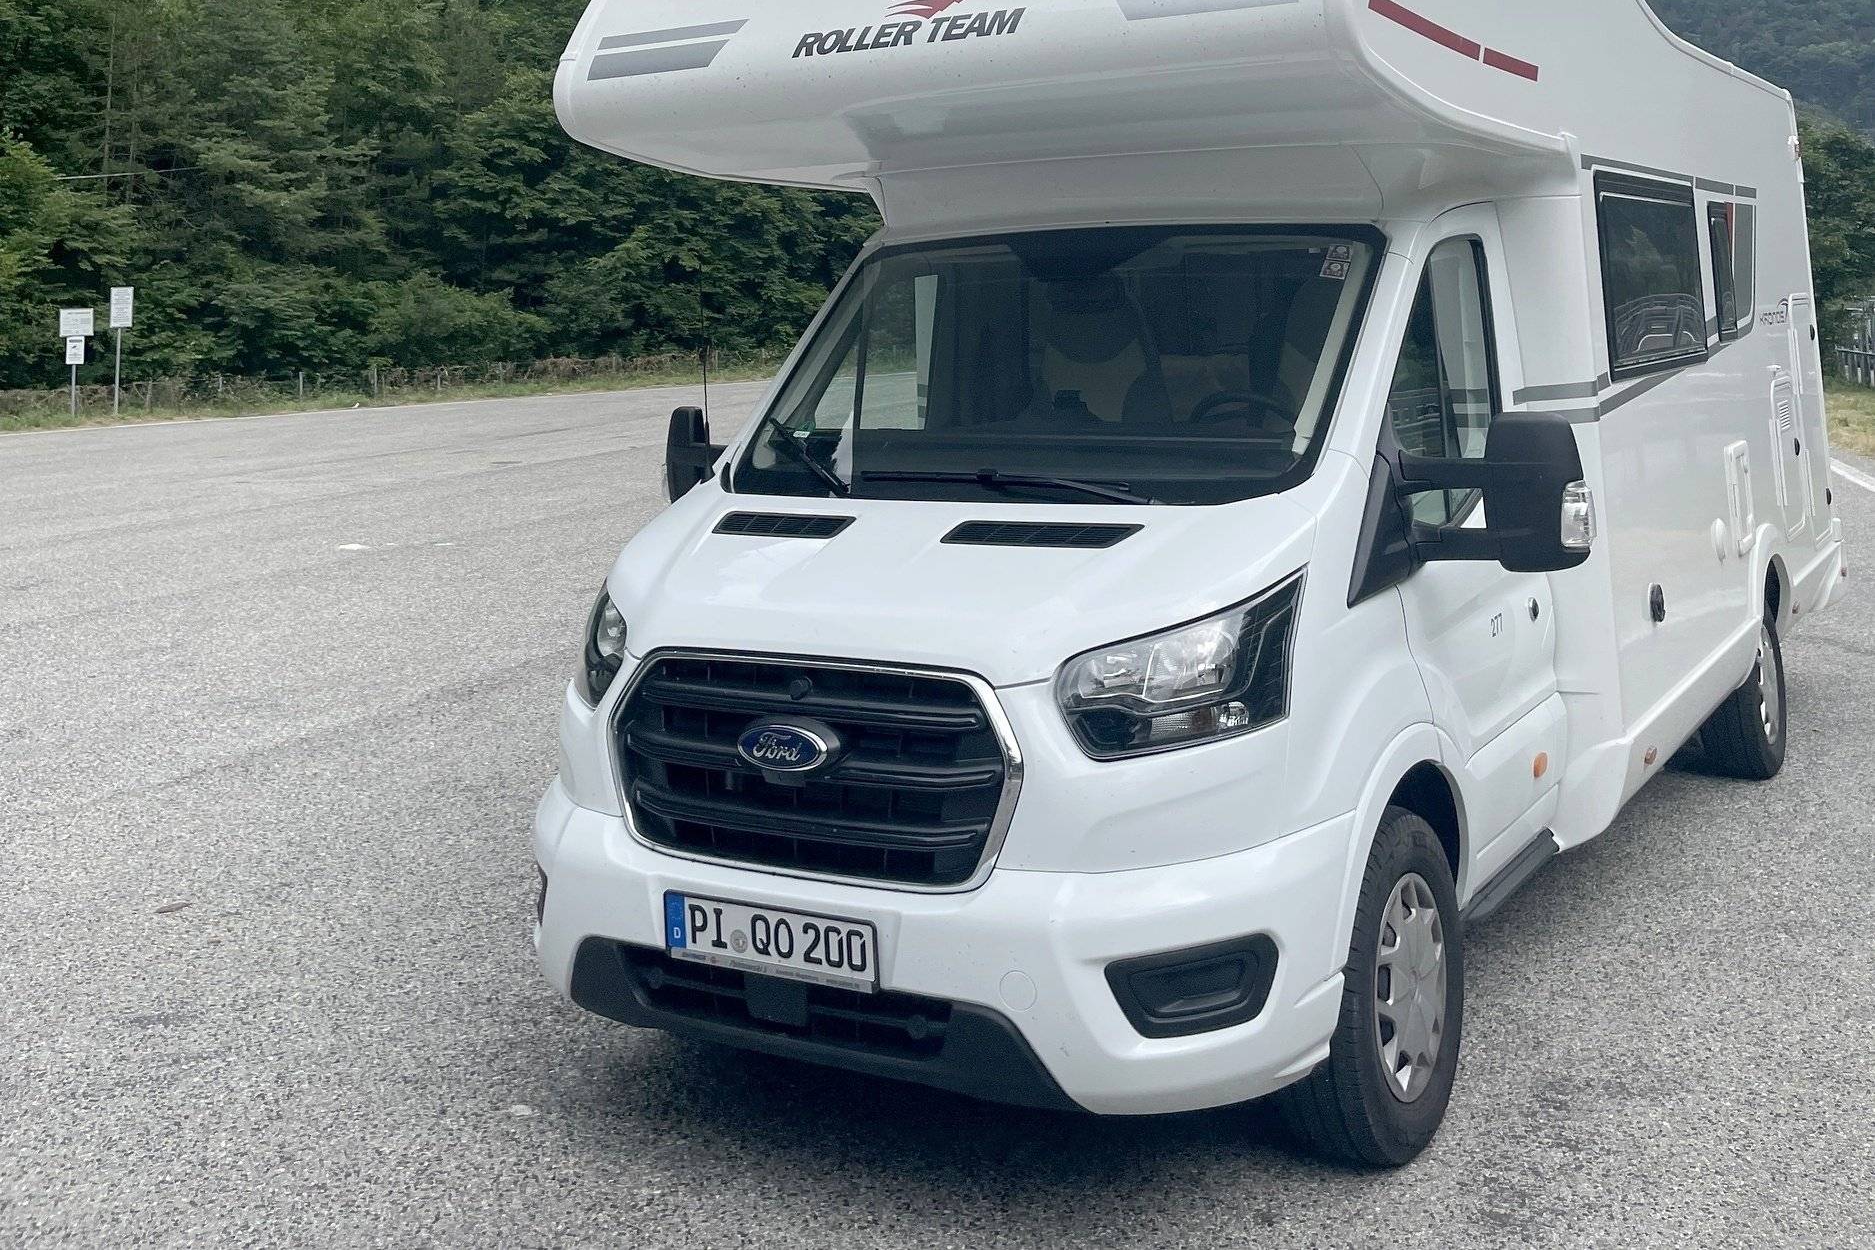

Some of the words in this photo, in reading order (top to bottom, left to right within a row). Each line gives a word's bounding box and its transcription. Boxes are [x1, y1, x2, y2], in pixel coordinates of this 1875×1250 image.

[791, 20, 922, 59] ROLLER
[926, 7, 1026, 43] TEAM
[753, 731, 802, 762] Ford
[673, 927, 681, 939] D
[688, 903, 728, 950] PI
[802, 921, 867, 972] 200
